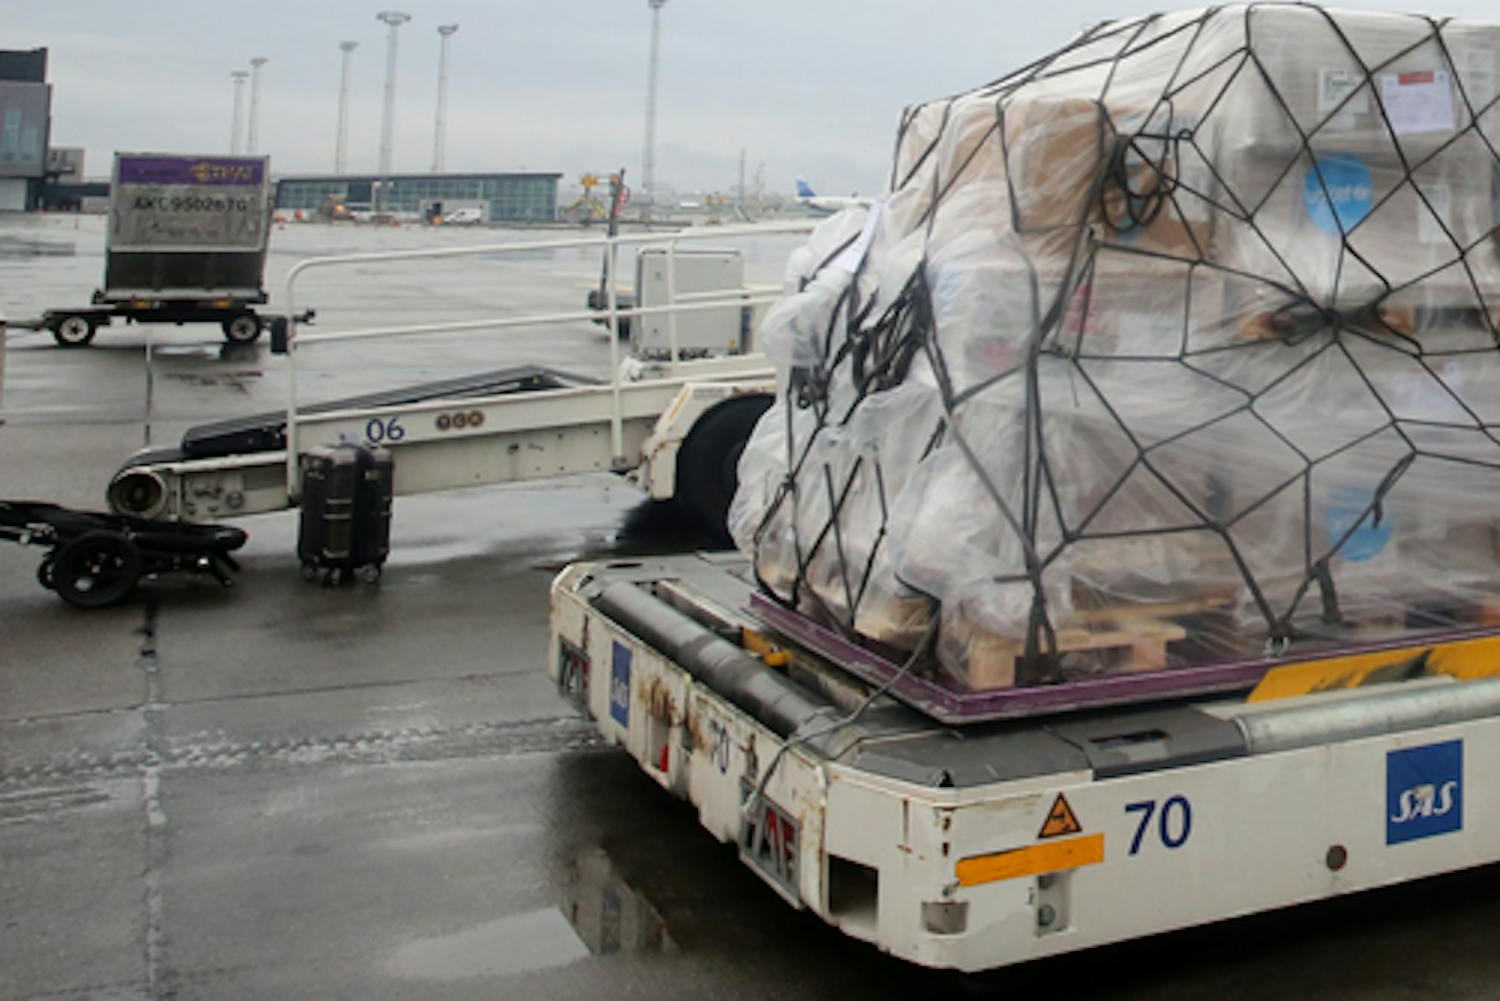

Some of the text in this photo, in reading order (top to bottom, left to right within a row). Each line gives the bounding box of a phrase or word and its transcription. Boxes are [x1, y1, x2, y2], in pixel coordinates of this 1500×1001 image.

[366, 416, 405, 443] 06
[1391, 780, 1457, 823] SAS
[1125, 794, 1192, 856] 70
